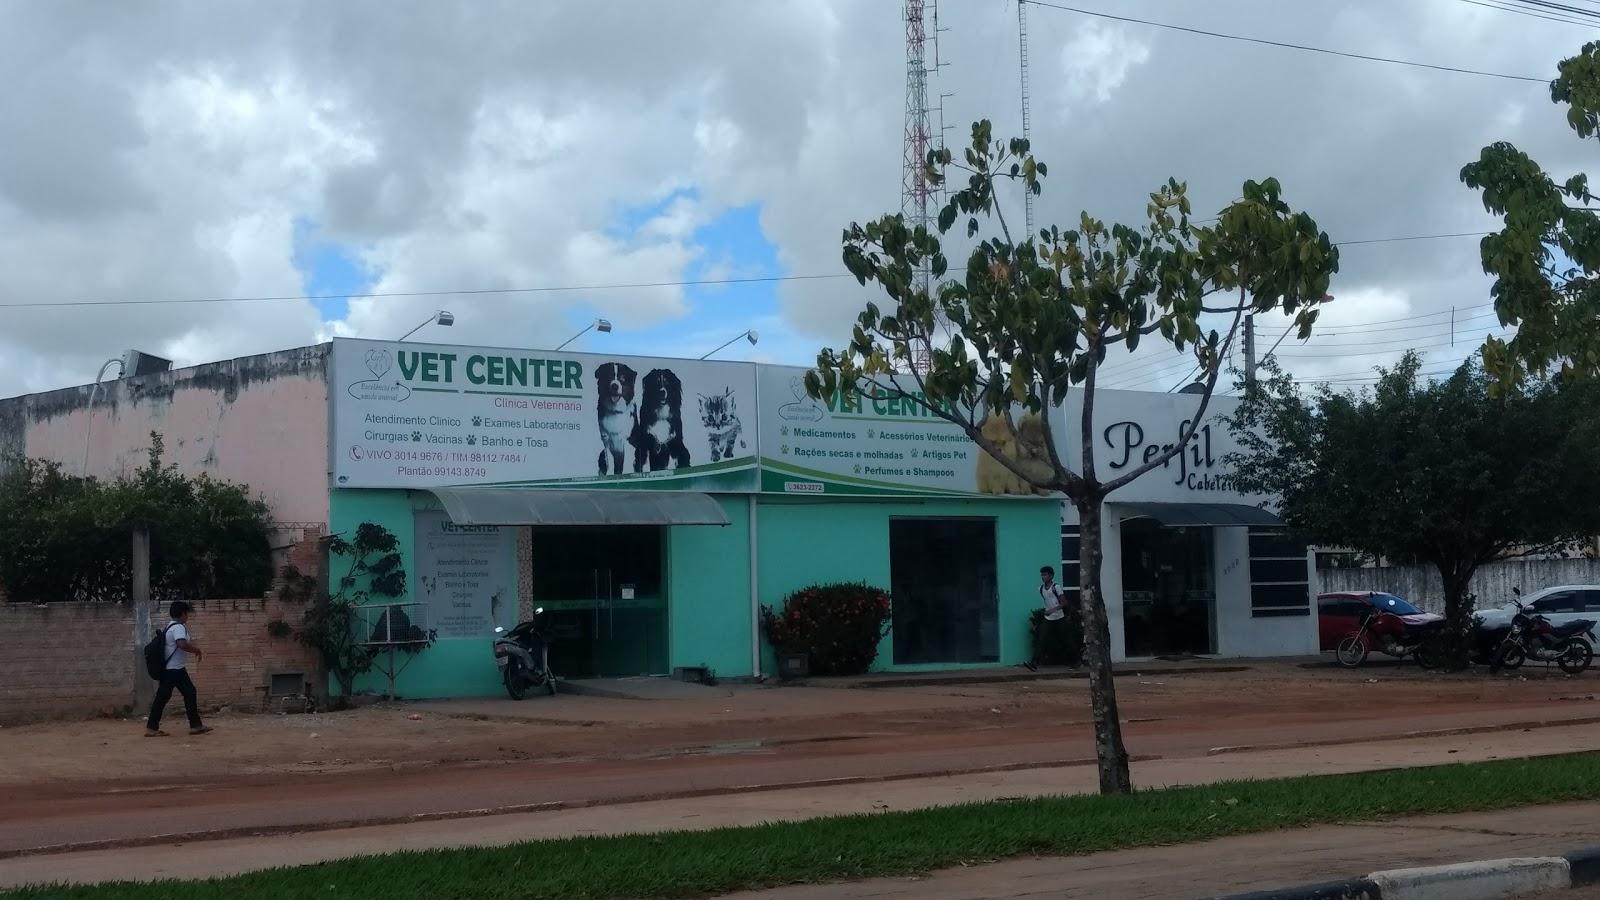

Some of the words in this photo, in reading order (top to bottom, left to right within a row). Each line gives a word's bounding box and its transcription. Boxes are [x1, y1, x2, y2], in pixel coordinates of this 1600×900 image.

[397, 350, 457, 383] VET
[465, 354, 583, 389] CENTER
[364, 413, 426, 425] Atendimento
[484, 418, 521, 428] Exames
[523, 419, 581, 431] Laboratoriais
[364, 430, 409, 443] Cirurgias
[425, 433, 463, 445] Vacinas
[482, 435, 514, 447] Banho
[525, 437, 548, 448] Tosa
[793, 427, 857, 439] Medicamentos
[880, 431, 925, 441] Acessórios
[366, 449, 392, 460] VIVO
[794, 447, 827, 458] Rações
[828, 450, 854, 458] secas
[864, 450, 904, 460] molhadas
[922, 450, 952, 461] Artigos
[953, 451, 967, 460] Pet
[1103, 419, 1216, 485] Perfil
[397, 465, 433, 476] Plantão
[864, 466, 904, 476] Perfumes
[913, 467, 955, 478] Shampoos
